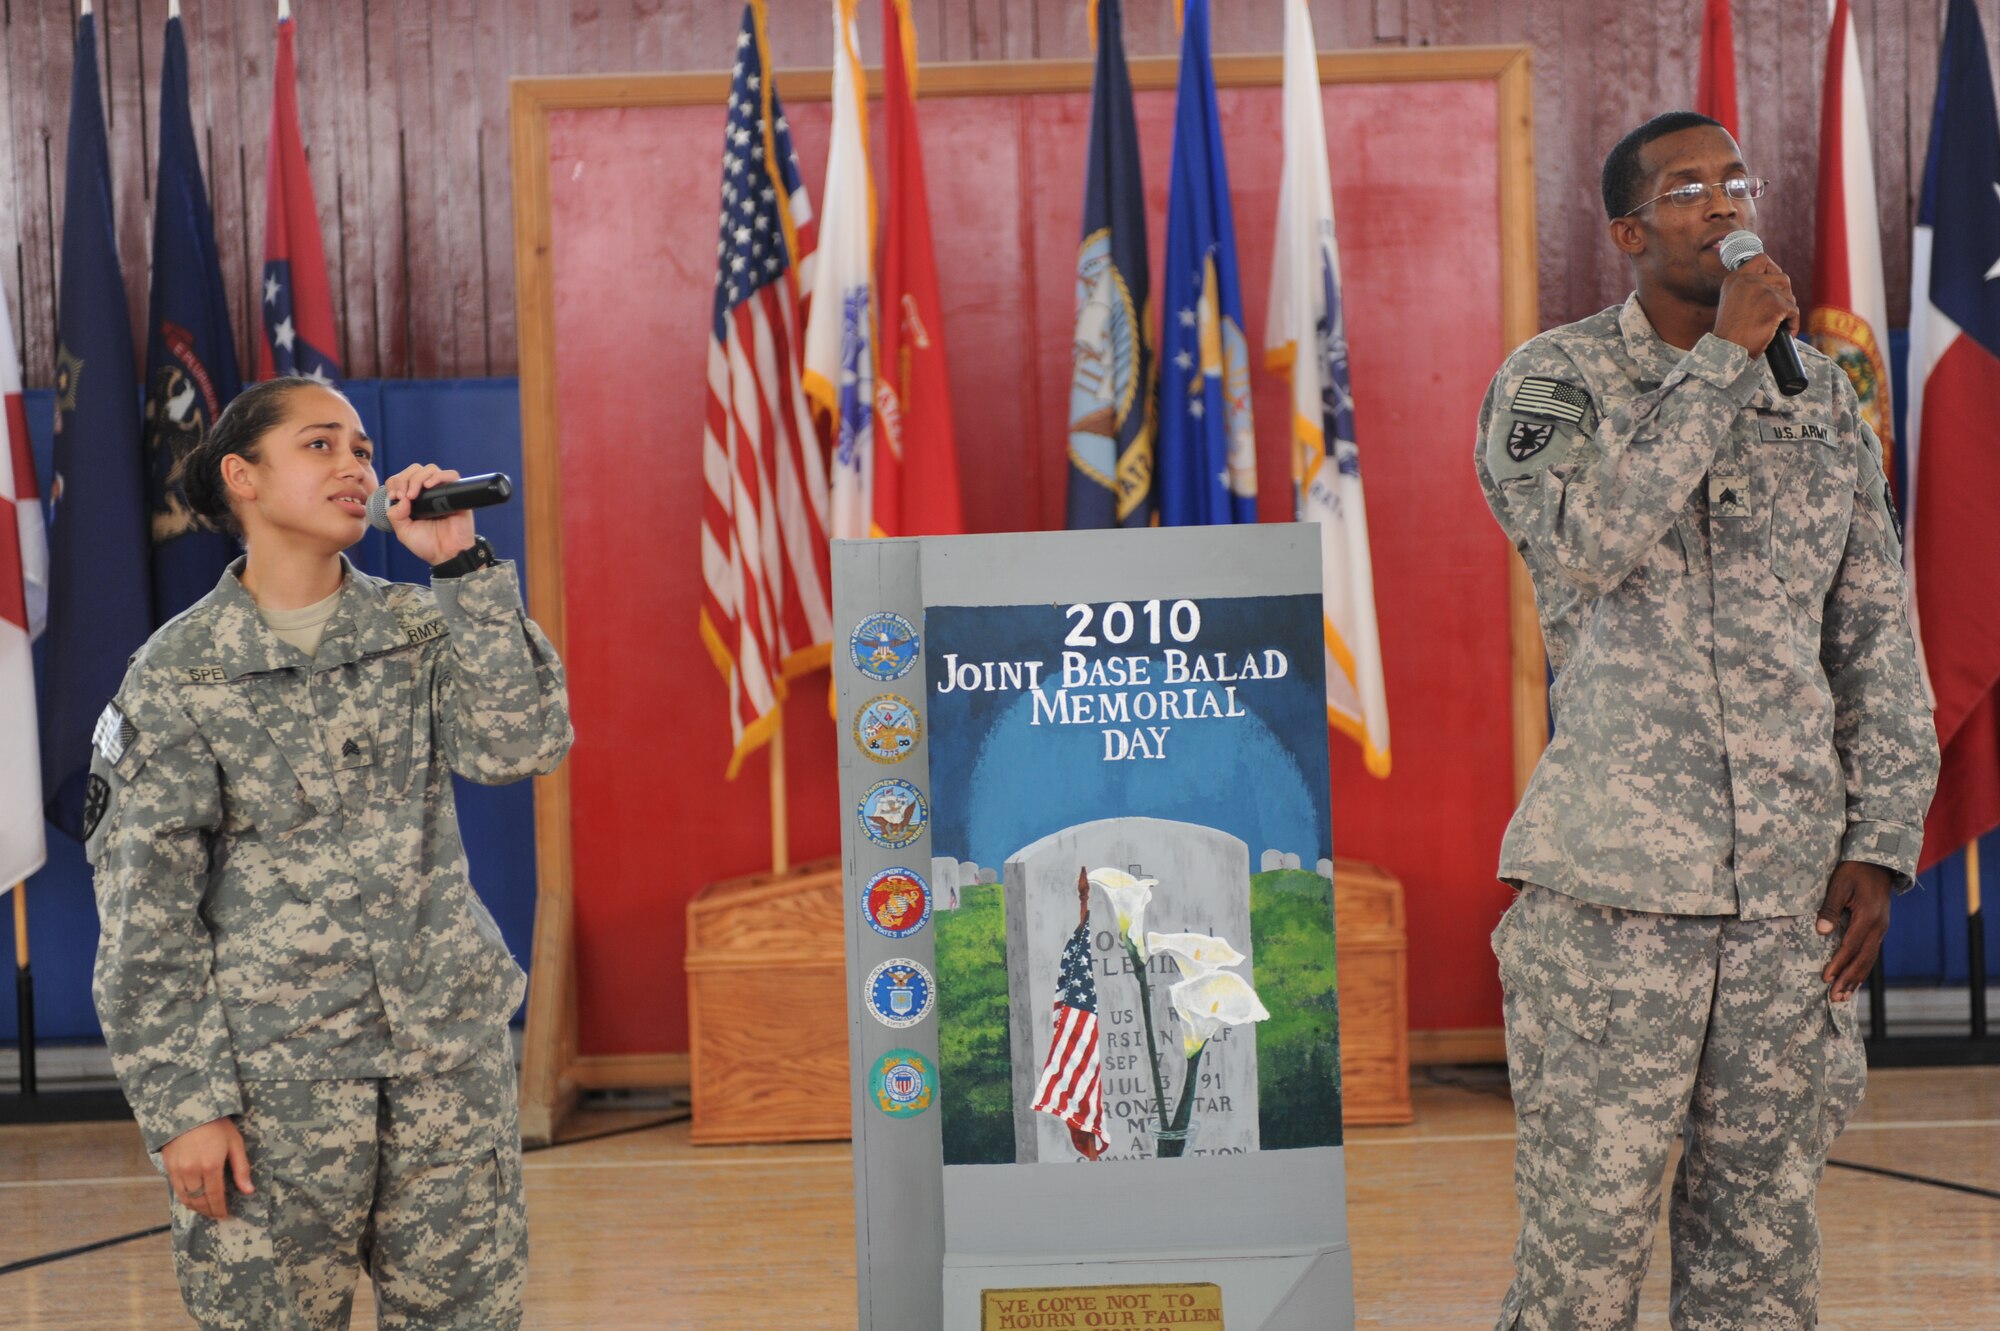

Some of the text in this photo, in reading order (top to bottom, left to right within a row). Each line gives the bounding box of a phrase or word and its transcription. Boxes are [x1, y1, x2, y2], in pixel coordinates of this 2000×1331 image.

[1773, 425, 1828, 442] U.S. ARMY
[1064, 599, 1201, 647] 2010
[937, 649, 1289, 693] JOINT BASE BALAD
[1030, 686, 1246, 726] MEMORIAL
[880, 749, 900, 758] 1775
[1101, 726, 1171, 761] DAY
[866, 868, 904, 889] DEPARTMENT
[862, 895, 932, 938] UNITED STATES MARINE CORPS
[1109, 1009, 1134, 1025] US
[1105, 1055, 1138, 1071] SEP
[1103, 1077, 1147, 1096] JUL
[1037, 1296, 1097, 1313] COME
[1105, 1294, 1152, 1310] NOT
[1162, 1293, 1195, 1308] TO
[999, 1308, 1221, 1330] MOURN OUR FALLEN
